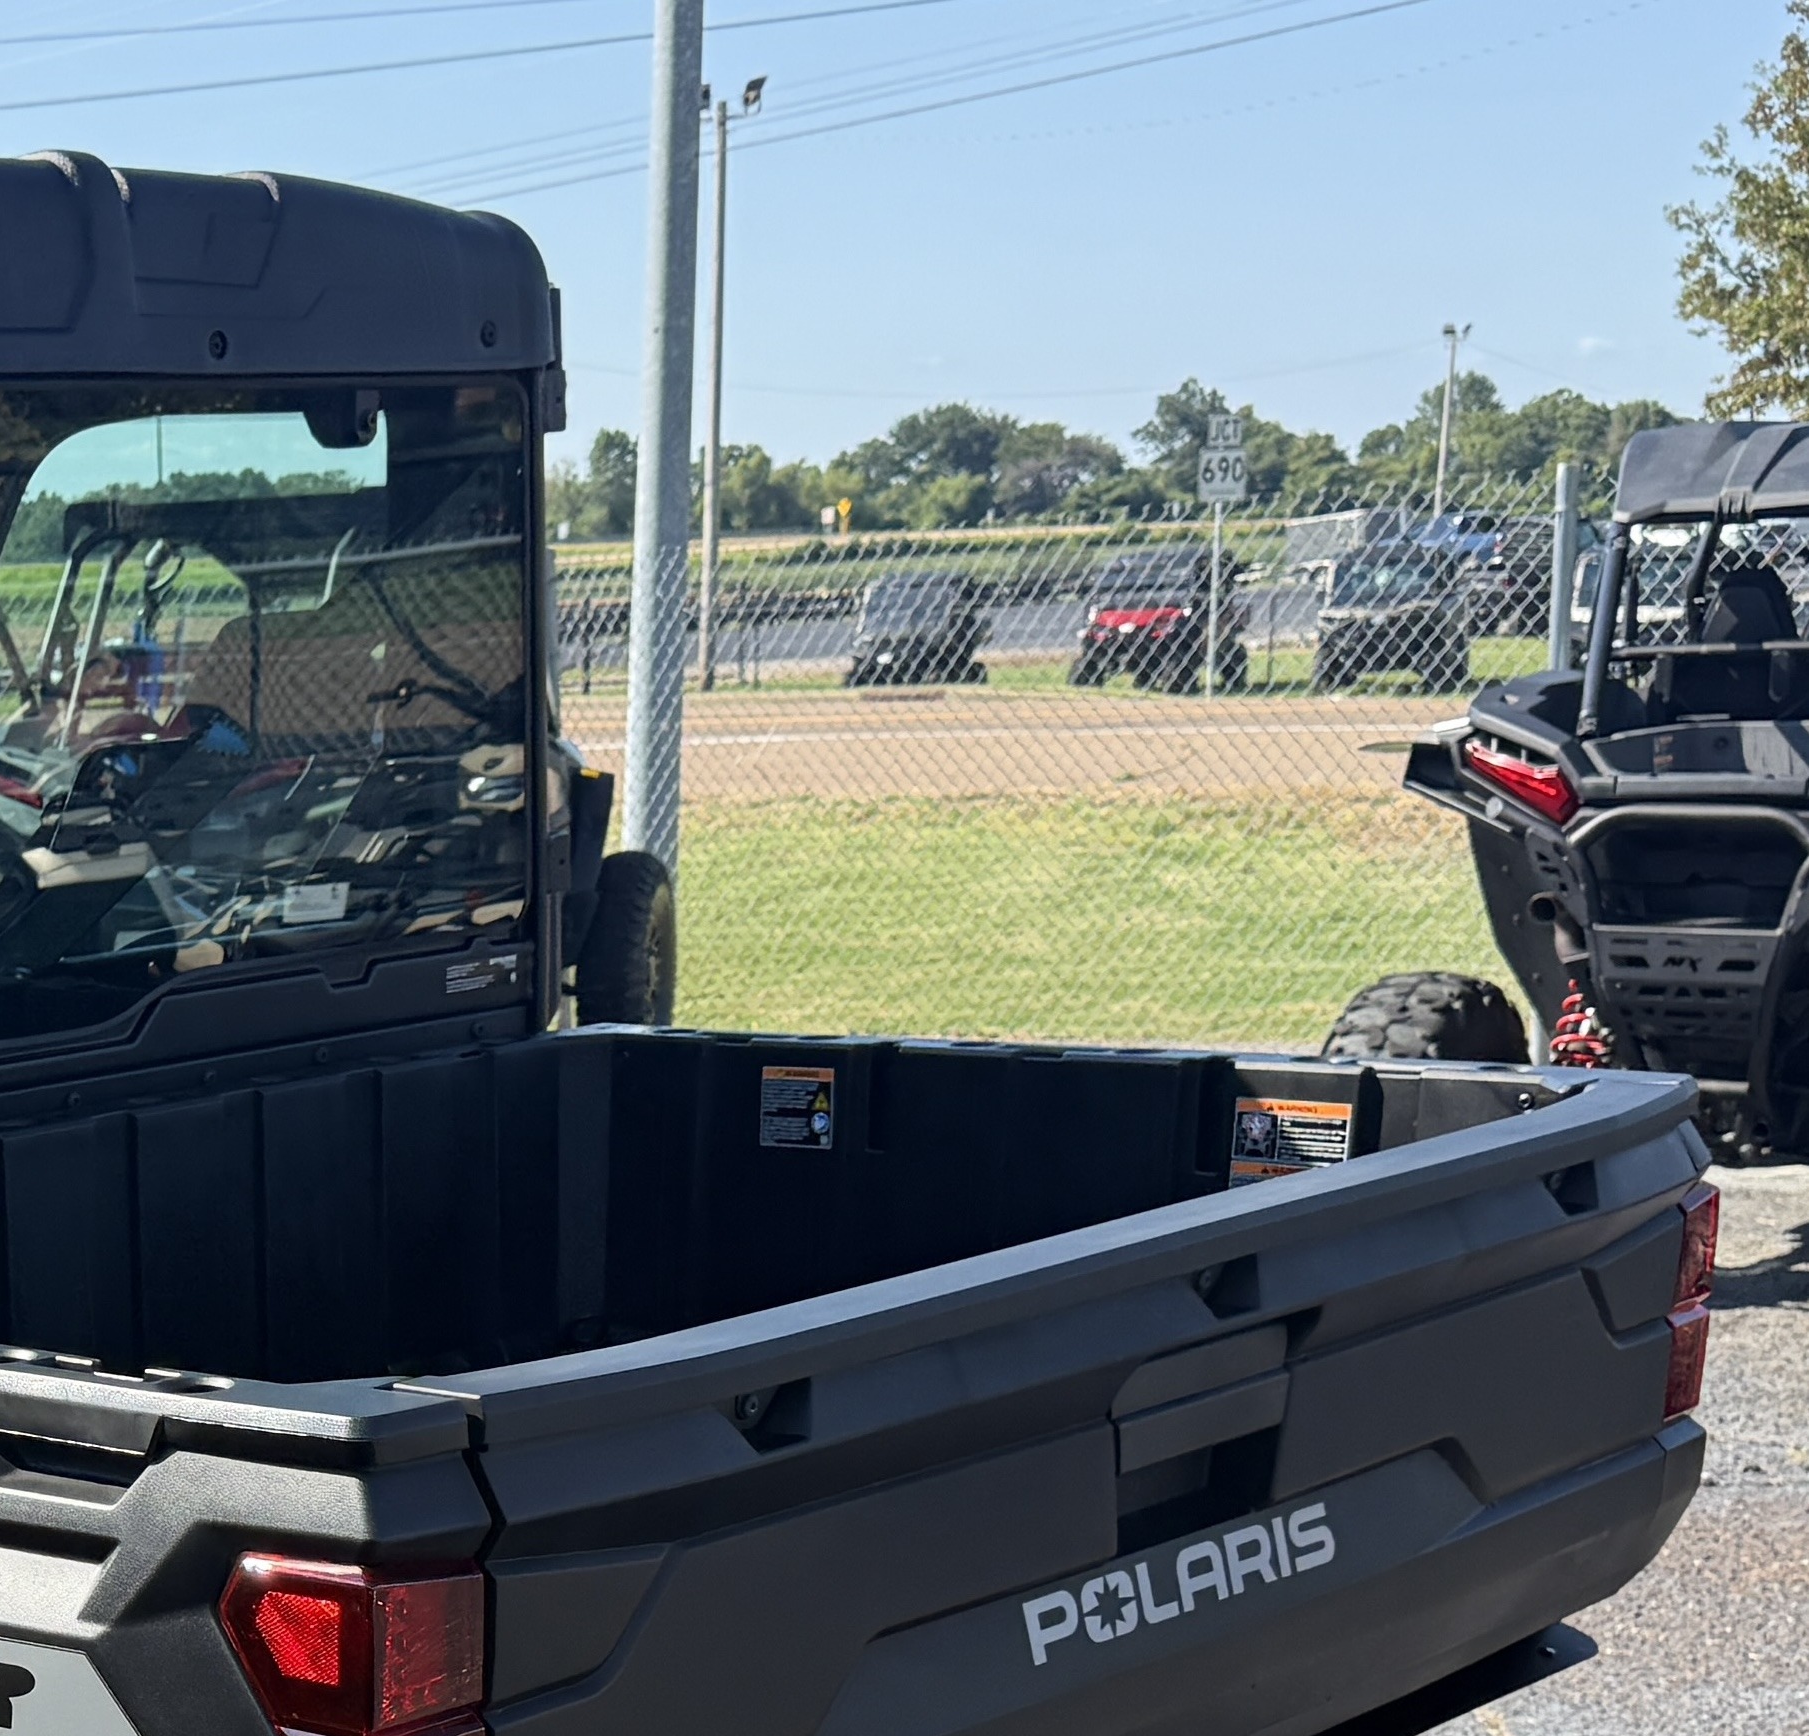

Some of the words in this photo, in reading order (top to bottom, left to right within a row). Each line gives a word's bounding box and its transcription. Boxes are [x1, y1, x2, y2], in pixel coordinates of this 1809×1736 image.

[1211, 418, 1241, 441] JCT
[1202, 456, 1244, 484] 690
[1022, 1502, 1336, 1666] POLARIS
